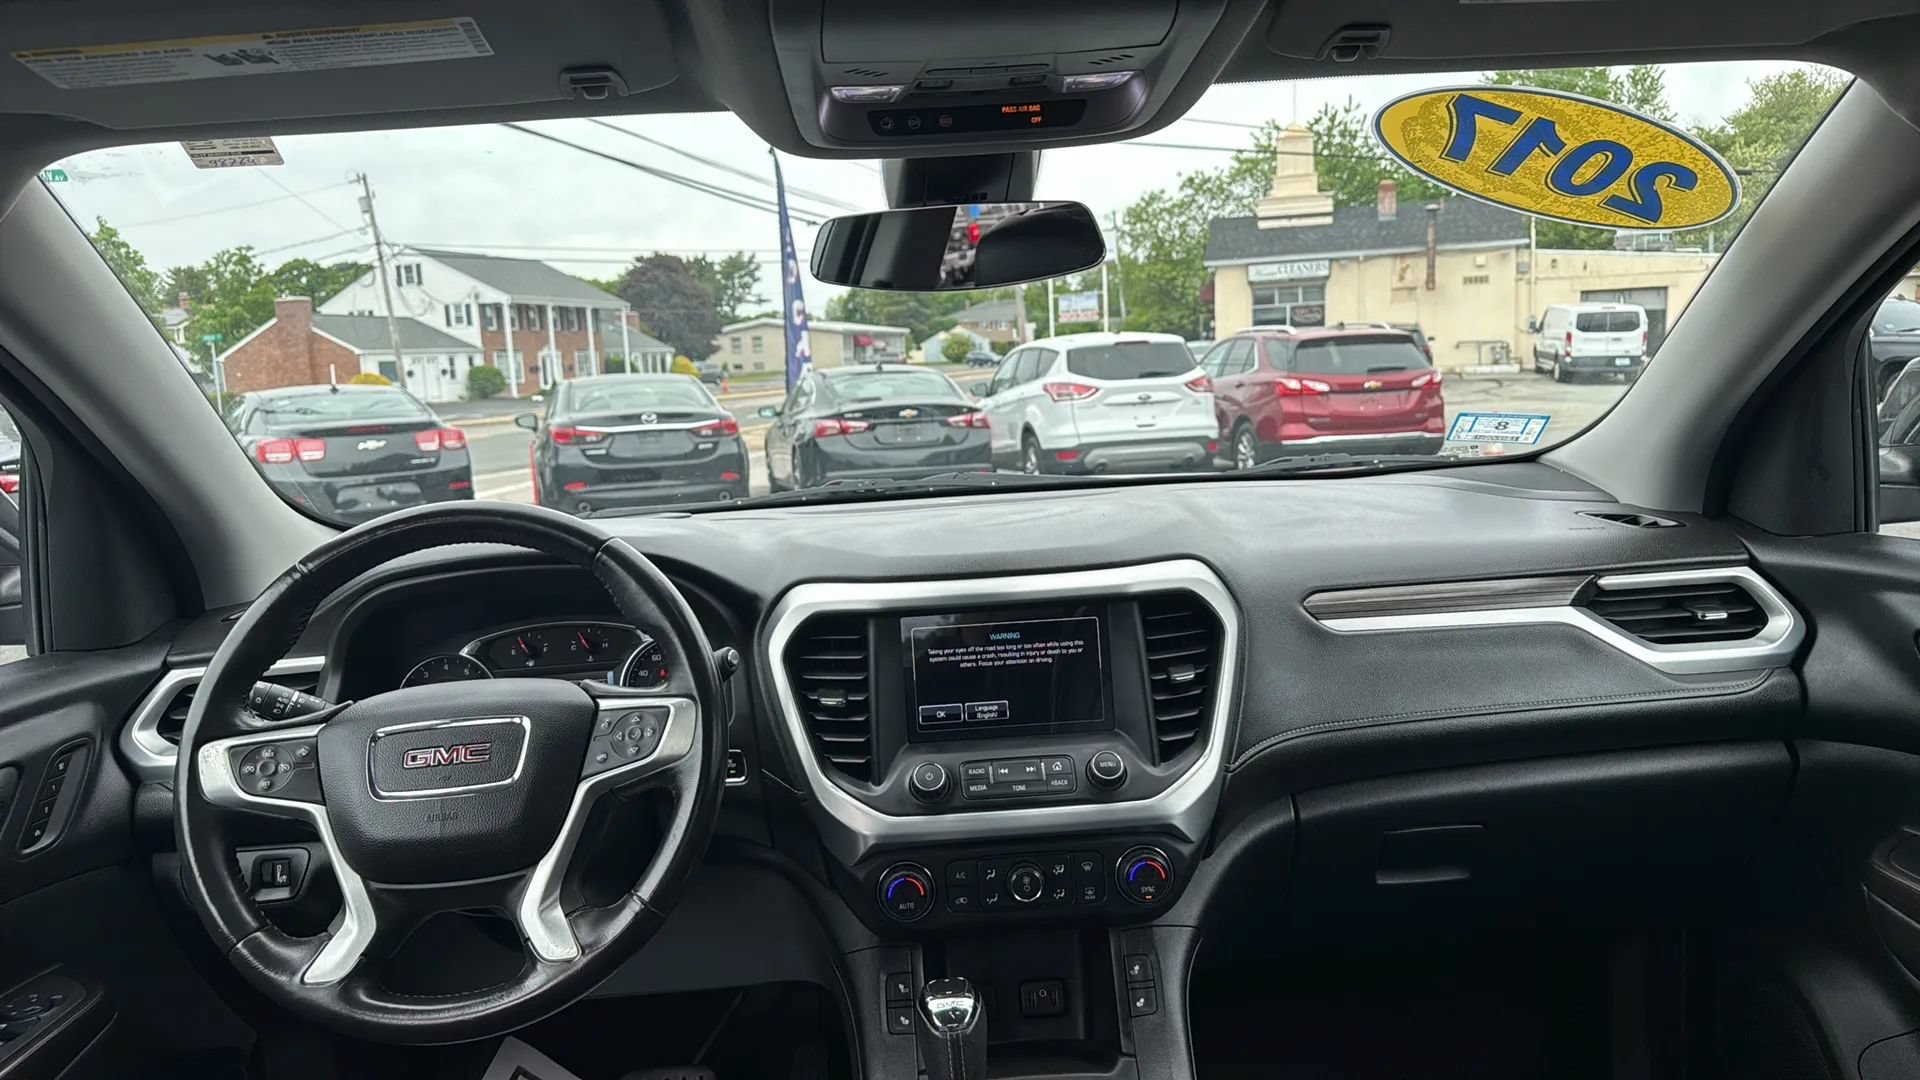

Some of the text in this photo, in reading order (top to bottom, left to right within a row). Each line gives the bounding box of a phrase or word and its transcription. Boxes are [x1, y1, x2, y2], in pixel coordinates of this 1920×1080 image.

[1029, 104, 1041, 112] BAG
[1277, 263, 1327, 274] CLEANERS
[1494, 421, 1510, 431] 8
[989, 632, 1021, 640] WARNING
[651, 654, 662, 662] 60
[974, 704, 999, 713] Language
[976, 711, 998, 720] (English)
[403, 742, 492, 769] GMC
[1140, 885, 1156, 893] SYNC
[898, 902, 915, 911] AUTO
[936, 1000, 965, 1010] GMC
